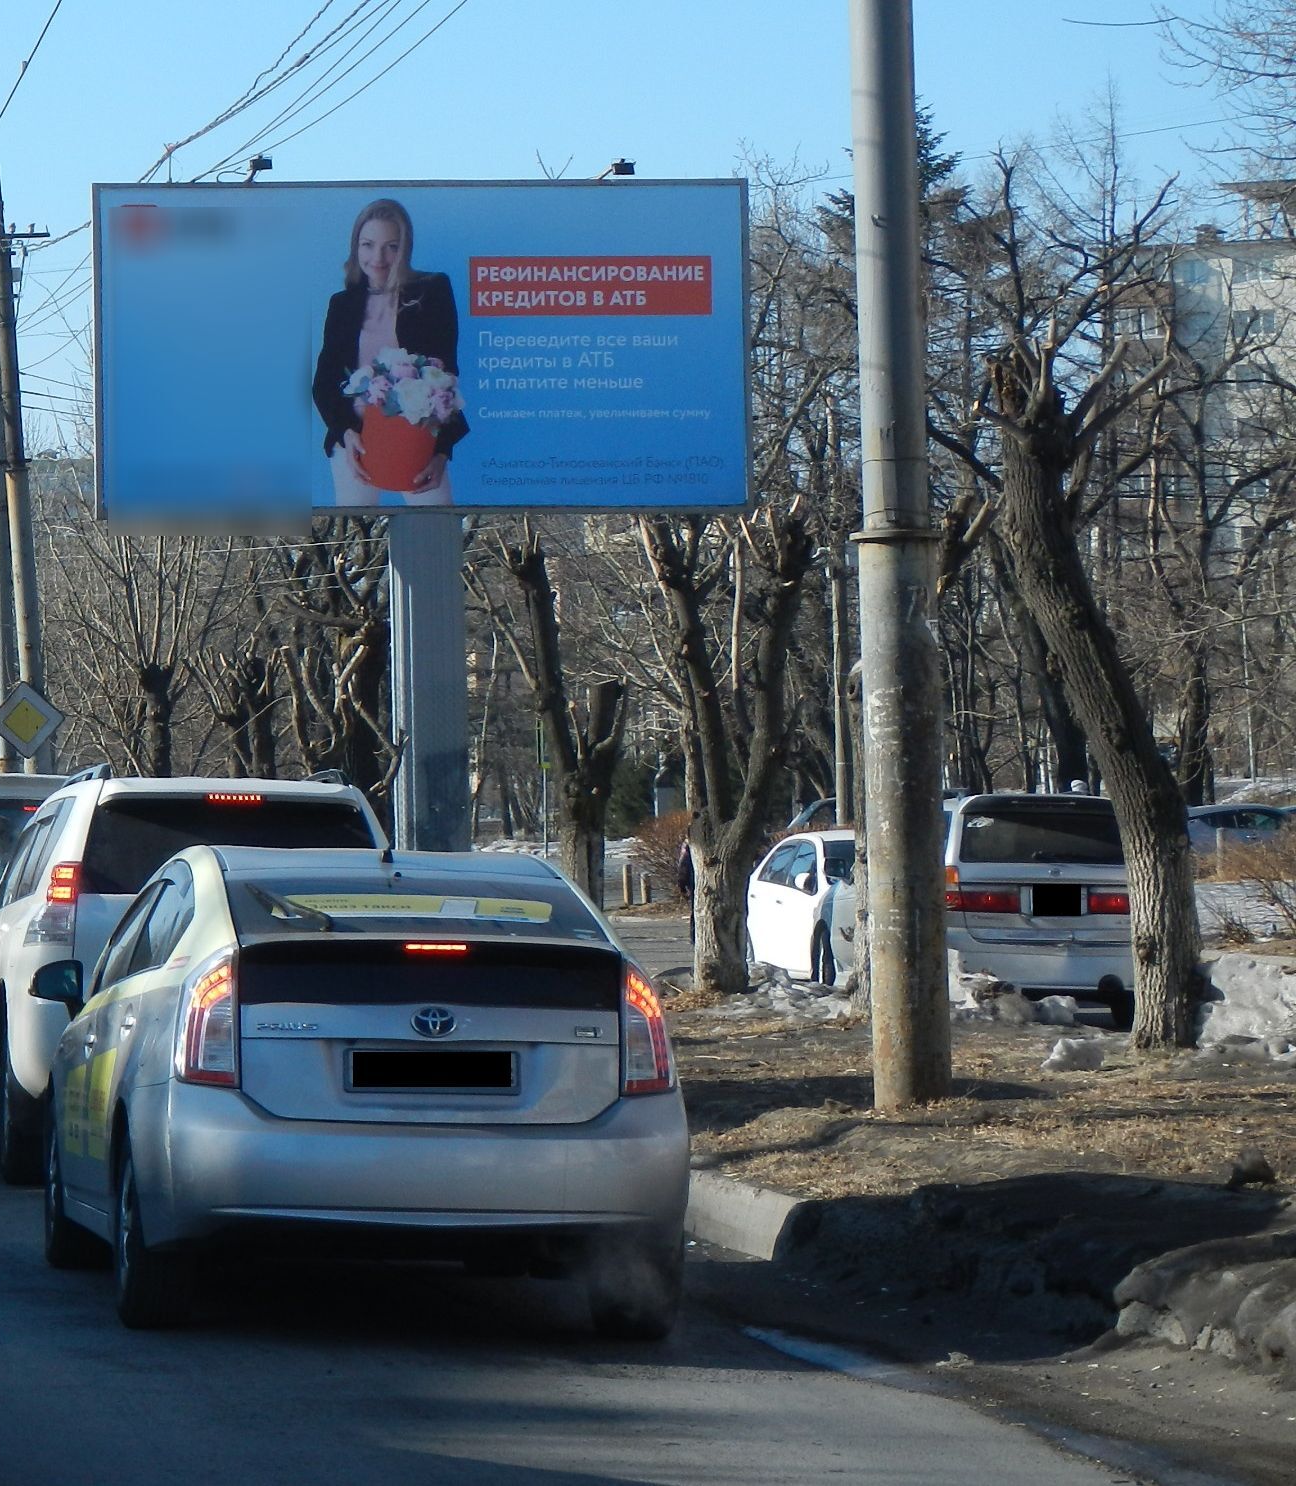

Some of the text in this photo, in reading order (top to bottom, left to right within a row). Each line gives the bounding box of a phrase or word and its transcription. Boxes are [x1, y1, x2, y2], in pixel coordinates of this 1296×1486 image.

[477, 265, 704, 282] РЕФИНАНСИРОВАНИЕ
[477, 290, 647, 309] КРЕДИТОВ В АТБ
[479, 331, 678, 350] Переведите все ваши
[478, 352, 615, 372] кредиты в АТБ
[479, 377, 644, 390] и платите меньше
[478, 407, 711, 420] Снижаем платеж, увеличиваем сумму
